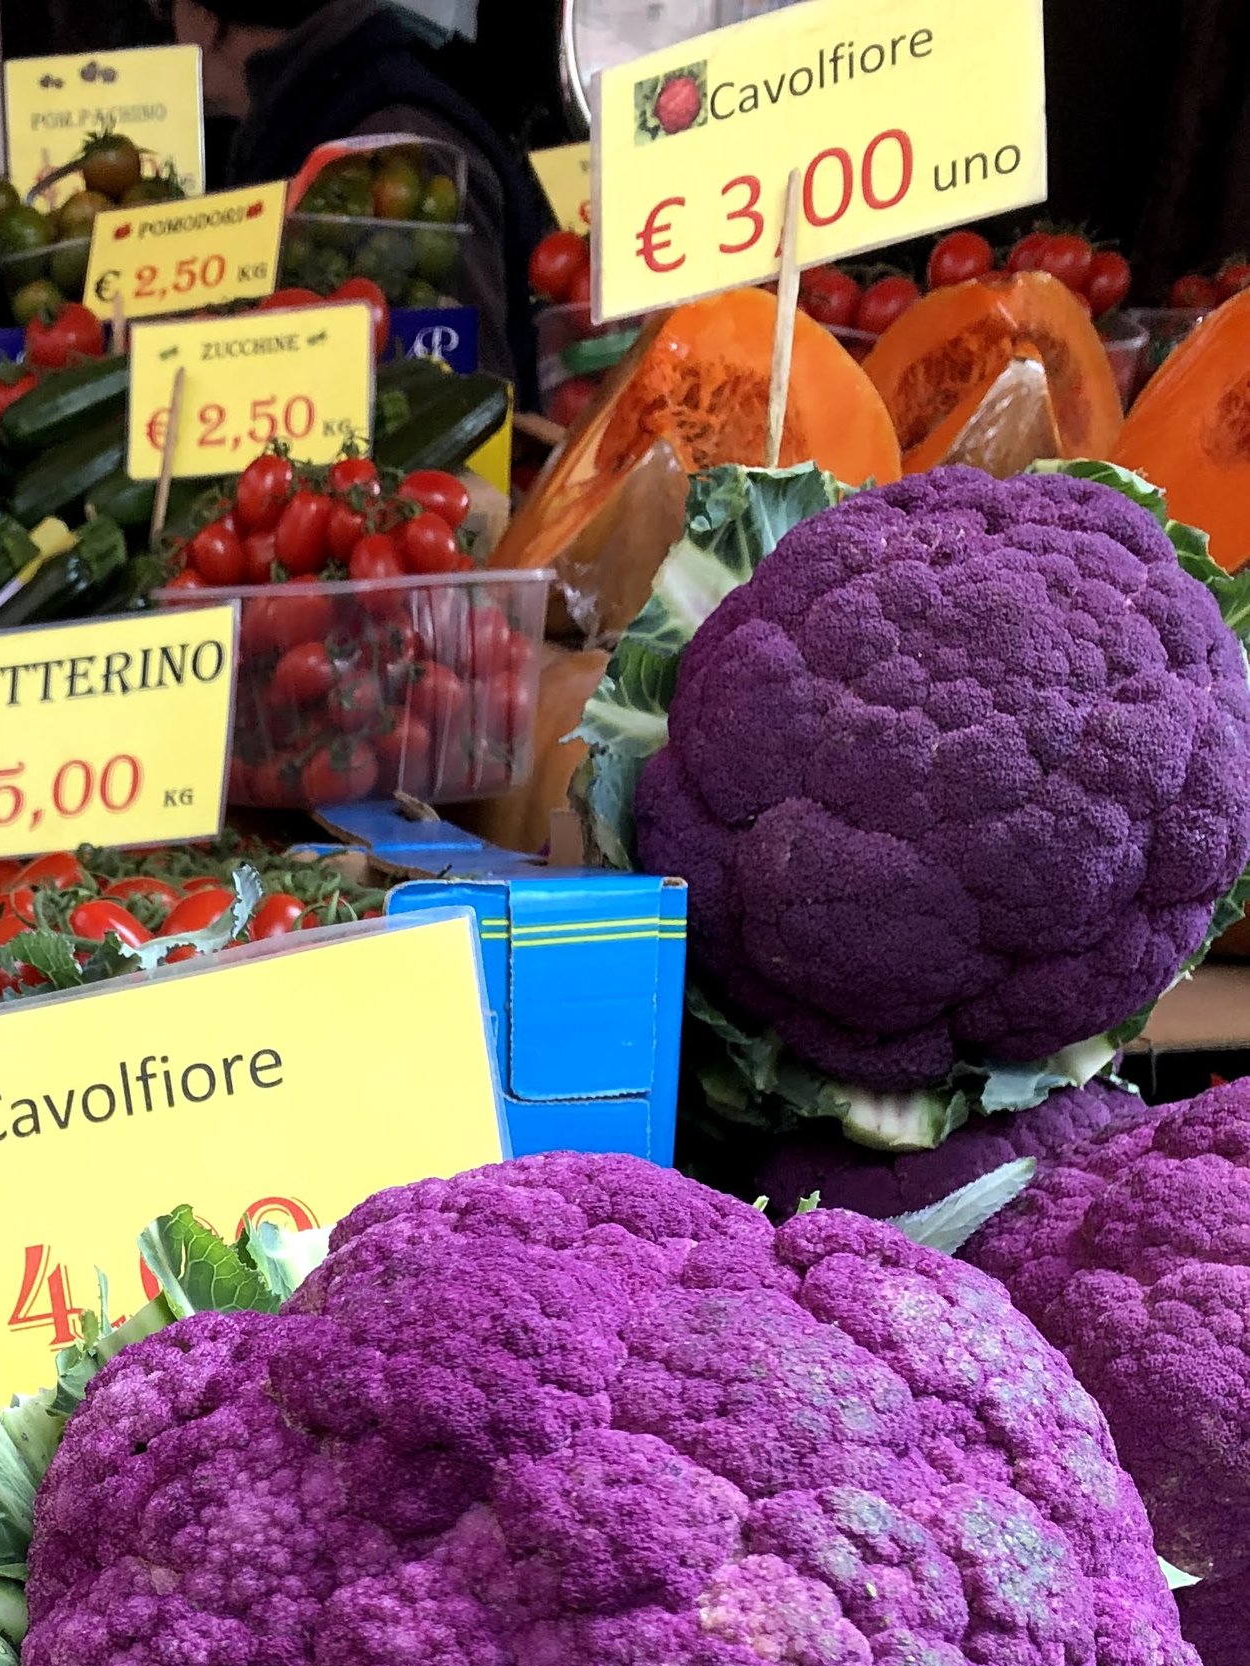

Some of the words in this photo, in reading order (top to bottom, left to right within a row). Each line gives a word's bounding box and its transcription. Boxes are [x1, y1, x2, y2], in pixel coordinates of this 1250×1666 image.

[708, 28, 934, 120] Cavolfiore
[138, 206, 246, 238] POMODORI
[635, 197, 687, 273] €
[932, 144, 1022, 192] uno
[95, 270, 121, 301] €
[134, 254, 226, 299] 2,50
[237, 262, 268, 282] KG
[201, 334, 301, 361] ZUCCHINE
[197, 394, 316, 453] 2,50
[322, 419, 351, 436] KG
[163, 788, 195, 808] KG
